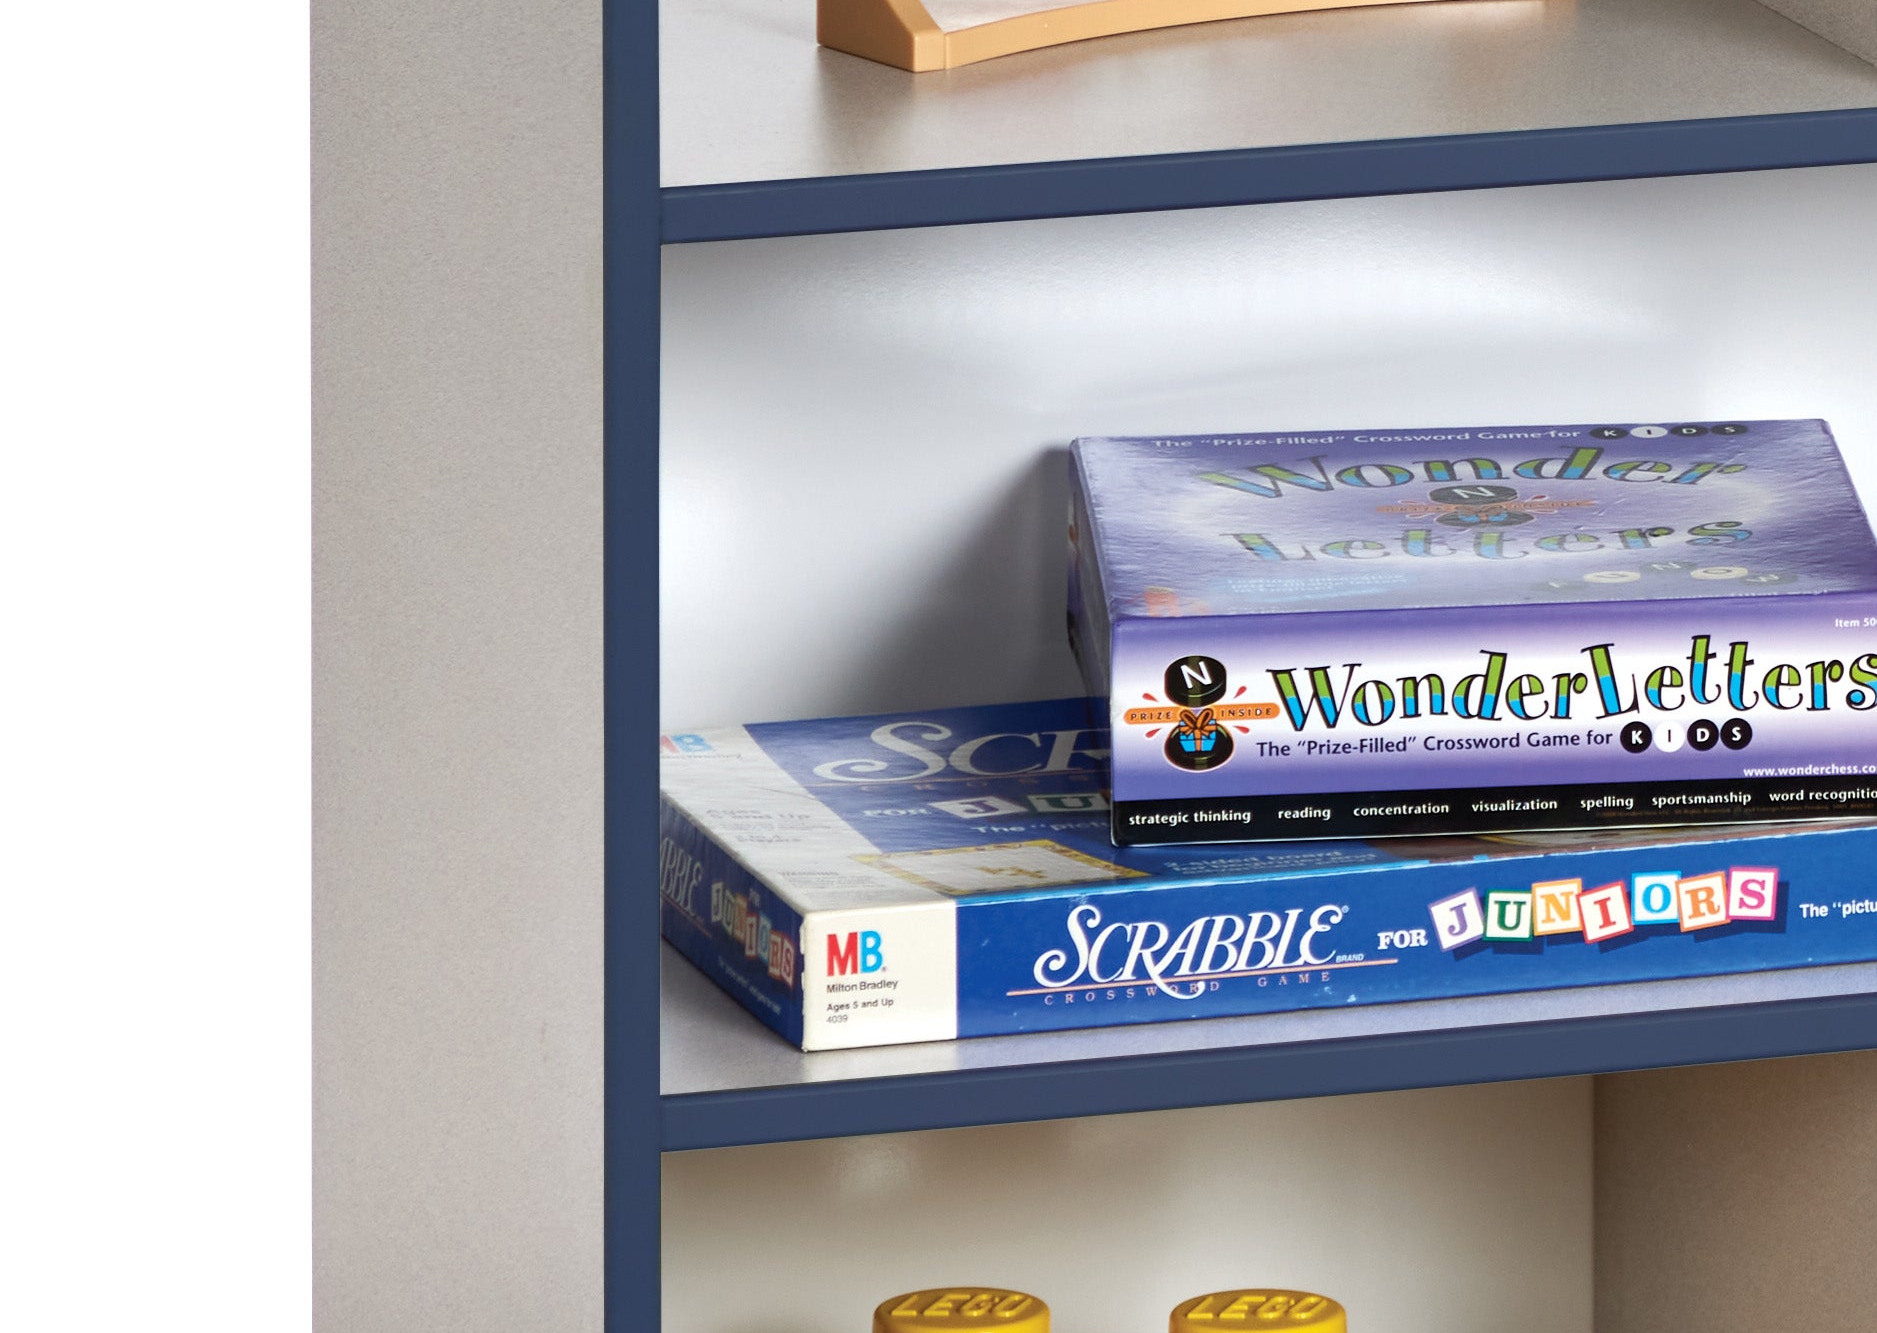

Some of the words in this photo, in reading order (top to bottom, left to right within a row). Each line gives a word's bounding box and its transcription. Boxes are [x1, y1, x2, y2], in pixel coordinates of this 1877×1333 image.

[1153, 439, 1193, 450] The
[1201, 435, 1346, 449] "Prize-Filled"
[1354, 431, 1469, 444] Crossword
[1478, 430, 1544, 442] Game
[1549, 428, 1581, 440] for
[1197, 445, 1747, 499] Wonder
[1219, 520, 1754, 563] Letters
[1835, 618, 1860, 628] Item
[1130, 710, 1173, 722] PRIZE
[1220, 707, 1272, 719] INSIDE
[1256, 740, 1291, 758] The
[1297, 736, 1417, 756] "Prize-Filled"
[1424, 733, 1521, 752] Crossword
[1527, 731, 1581, 749] Game
[1586, 730, 1613, 746] for
[1627, 723, 1748, 748] KIDS
[1580, 795, 1634, 811] spelling
[1652, 791, 1752, 807] sportsmanship
[1769, 788, 1806, 803] word
[1353, 802, 1450, 818] concentration
[1471, 796, 1558, 814] visualization
[1128, 813, 1190, 827] strategic
[1193, 809, 1252, 825] thinking
[1278, 807, 1332, 822] reading
[1376, 928, 1429, 952] FOR
[1438, 873, 1773, 944] JUNIORS
[1799, 902, 1829, 919] The
[826, 929, 885, 978] MB
[1032, 903, 1344, 1000] SCRABBLE
[1335, 952, 1365, 964] BRAND
[826, 980, 857, 994] Milton
[859, 977, 898, 993] Bradley
[1044, 979, 1220, 1006] CROSSWORD
[1257, 970, 1332, 988] GAME
[827, 1001, 850, 1014] Ages
[852, 1000, 859, 1011] 5
[861, 998, 879, 1010] and
[881, 997, 894, 1010] Up
[827, 1013, 849, 1025] 4039
[891, 1293, 1033, 1319] LEGO
[1185, 1294, 1327, 1320] LEGO
